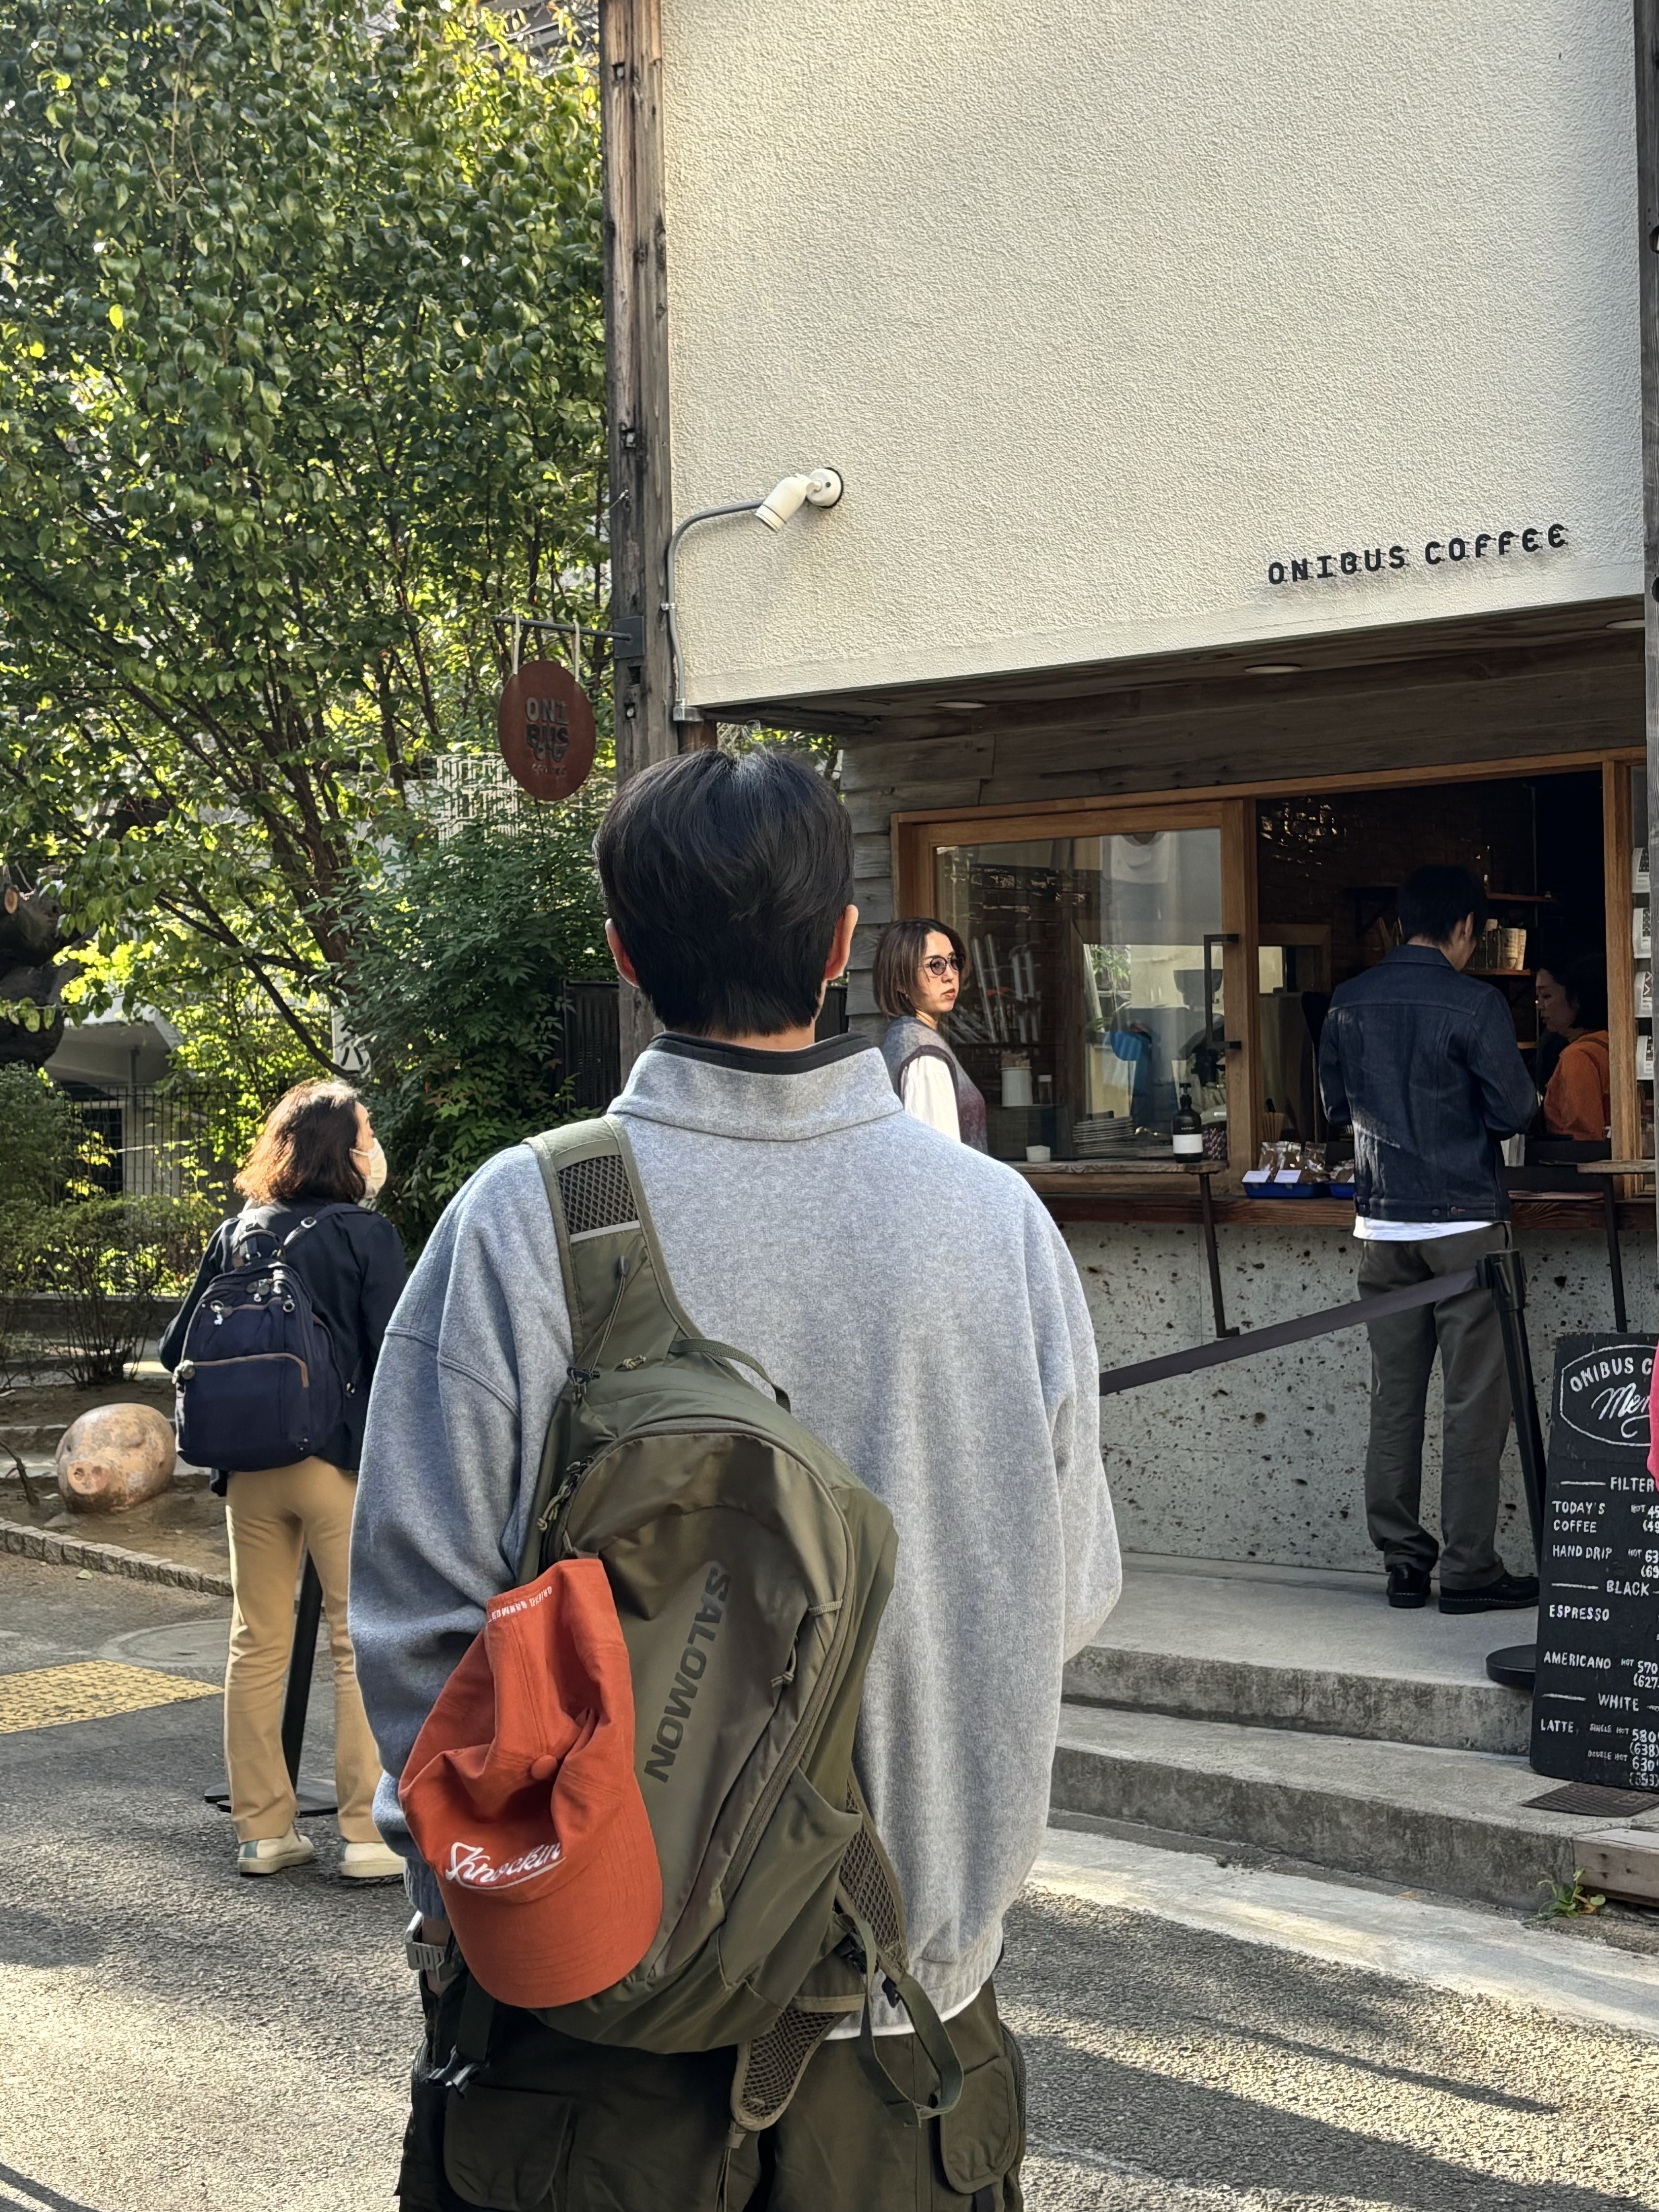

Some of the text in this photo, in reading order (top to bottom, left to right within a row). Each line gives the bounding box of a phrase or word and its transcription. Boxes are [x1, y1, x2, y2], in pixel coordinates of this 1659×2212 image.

[1268, 523, 1568, 585] ONIBUS COFFEE
[525, 697, 569, 725] ONI
[526, 725, 569, 757] BUS
[1570, 1357, 1634, 1392] ONIBUS
[1611, 1477, 1654, 1492] FILTER
[1552, 1501, 1605, 1515] TODAY'S
[1631, 1504, 1646, 1514] HOT
[1553, 1520, 1597, 1533] COFFEE
[1553, 1545, 1659, 1564] HAND DRIP HOT 63
[1607, 1580, 1650, 1596] BLACK
[1549, 1605, 1610, 1621] ESPRESSO
[1543, 1651, 1658, 1675] AMERICANO HOT 570
[644, 1566, 731, 1783] SALOMON
[1633, 1672, 1659, 1690] (627
[1597, 1693, 1639, 1712] WHITE
[1540, 1719, 1574, 1733] LATTE
[1616, 1727, 1630, 1735] HOT
[1587, 1750, 1612, 1761] DOUBLE
[1614, 1753, 1629, 1762] HOT
